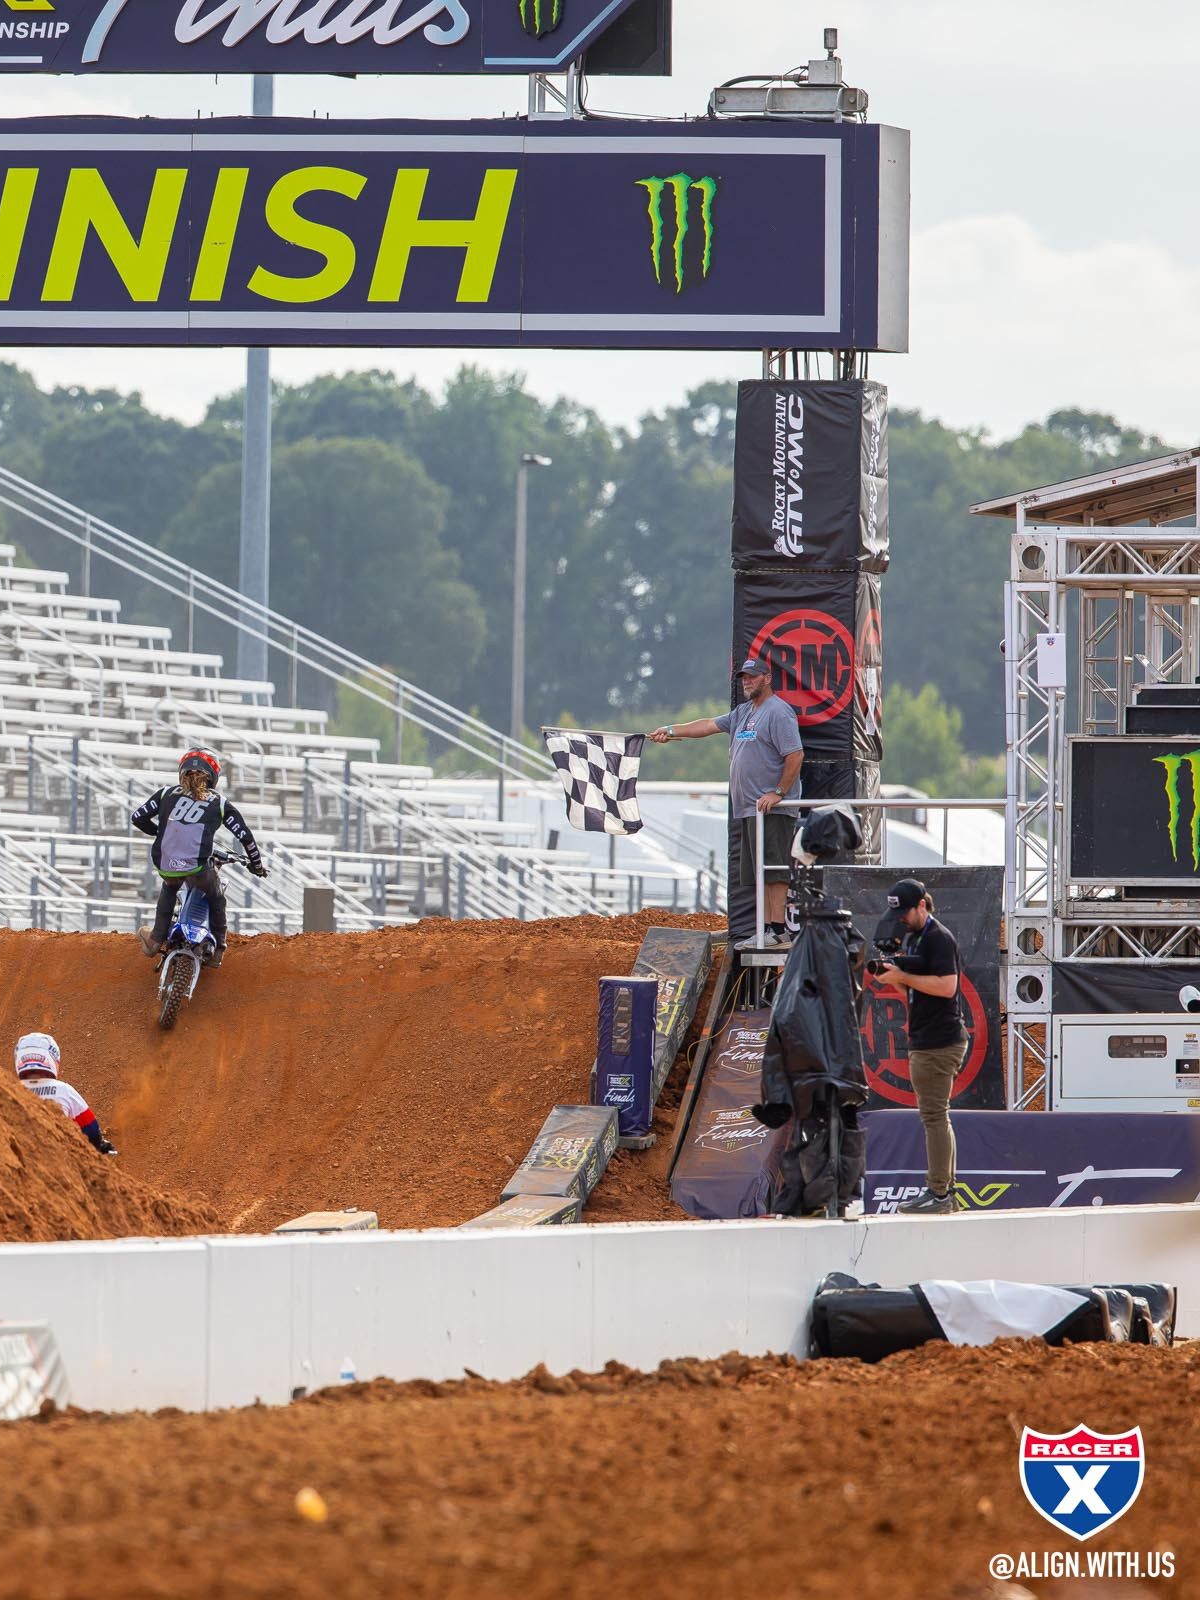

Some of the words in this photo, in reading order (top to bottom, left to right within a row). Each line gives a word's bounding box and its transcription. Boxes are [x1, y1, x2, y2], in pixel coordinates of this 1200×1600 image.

[773, 393, 787, 479] MOUNTAIN
[772, 481, 786, 532] ROCKY
[770, 644, 837, 690] RM
[169, 797, 209, 823] 86
[714, 1044, 766, 1063] Fina
[603, 1088, 635, 1102] Finals
[695, 1121, 770, 1143] Finals
[872, 1186, 929, 1201] SUP
